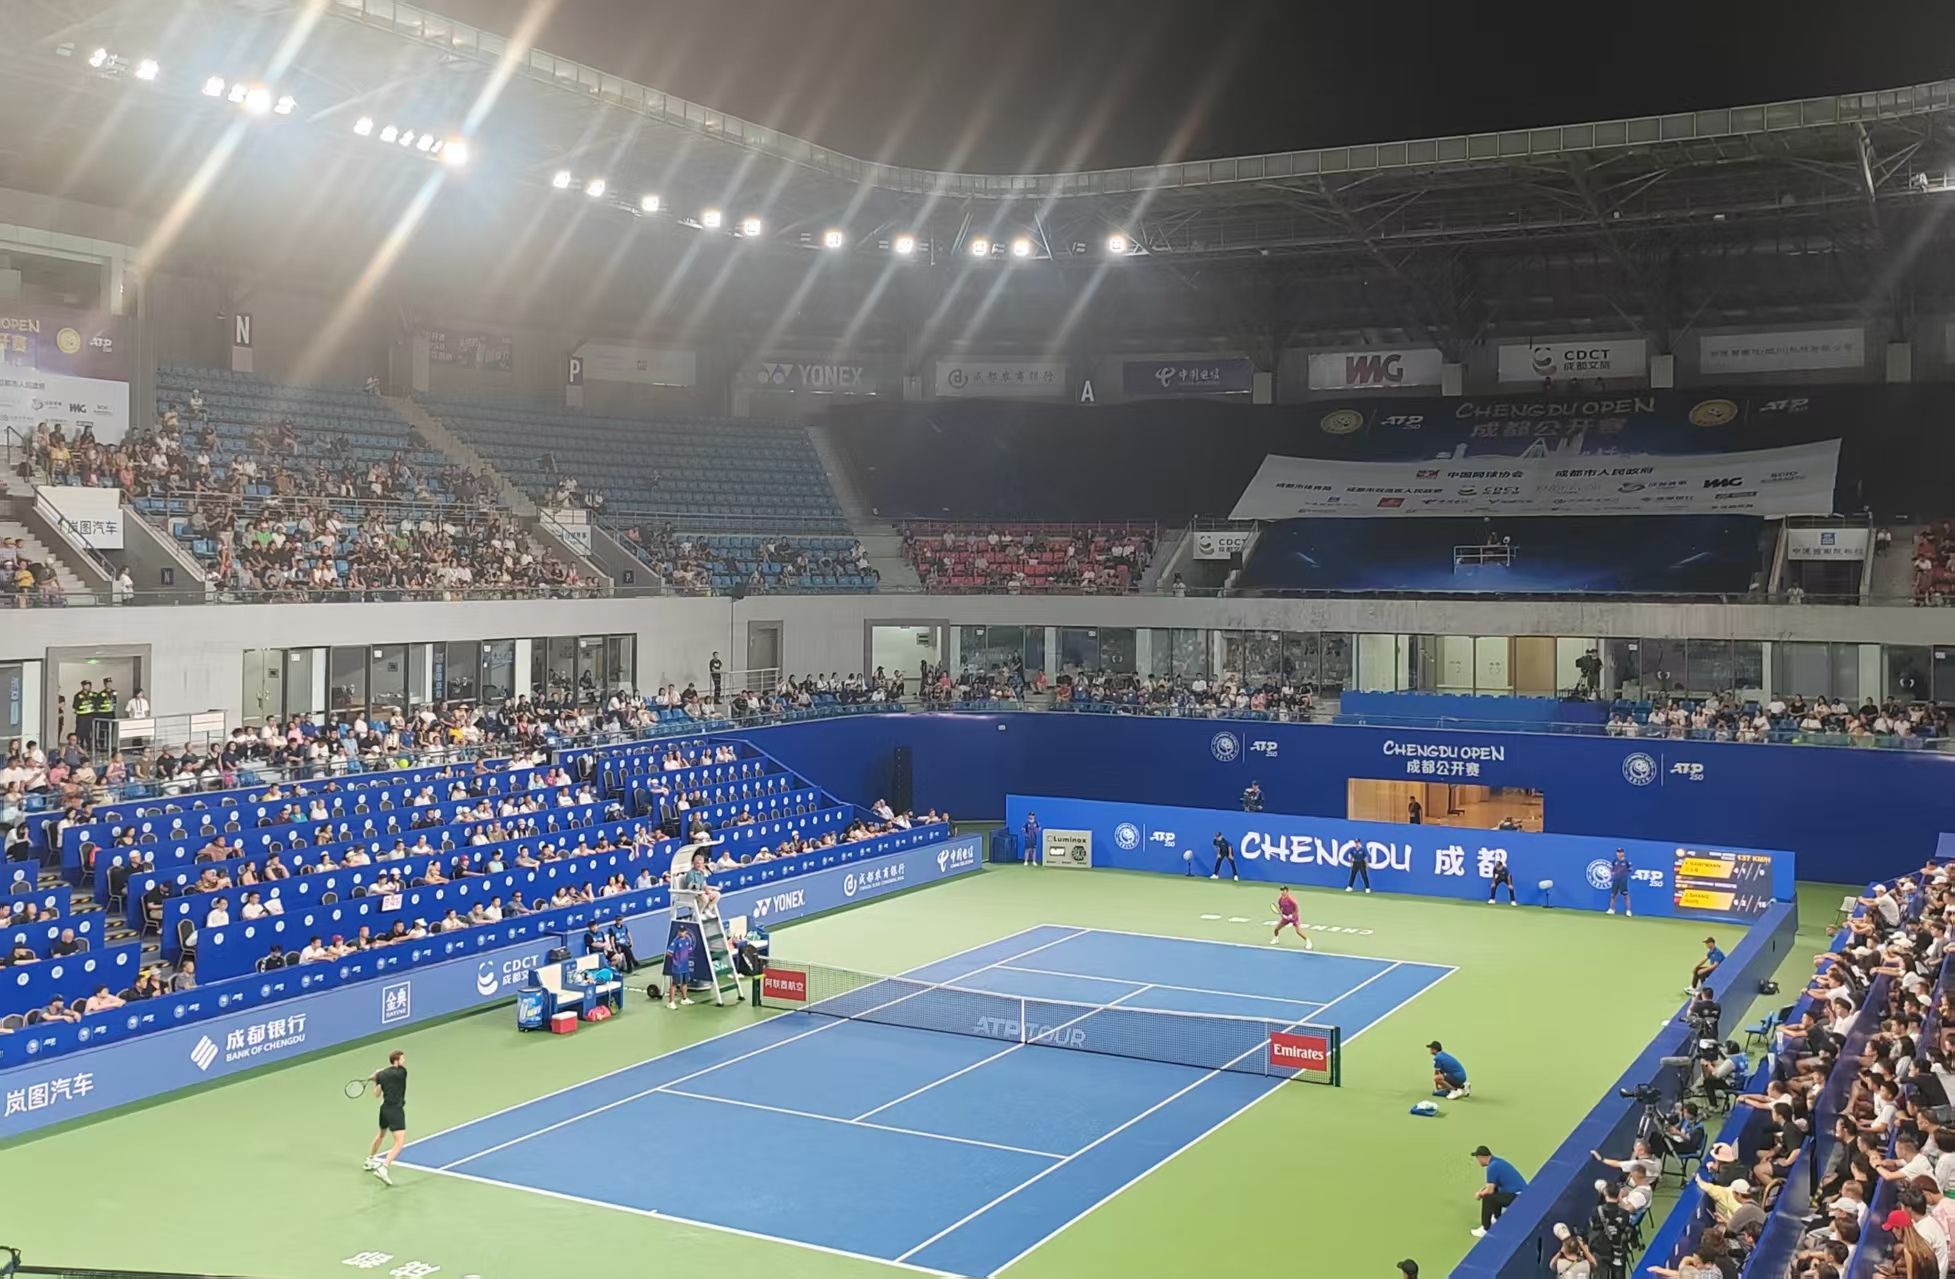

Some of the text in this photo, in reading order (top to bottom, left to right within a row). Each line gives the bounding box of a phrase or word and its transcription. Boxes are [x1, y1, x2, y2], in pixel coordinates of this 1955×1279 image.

[236, 314, 250, 345] N
[1564, 349, 1610, 361] CDCT
[569, 358, 581, 383] P
[798, 364, 864, 386] YONEX
[1080, 380, 1095, 402] A
[1455, 397, 1656, 419] CHENGDU OPEN
[1250, 741, 1278, 751] ATP
[1383, 740, 1505, 761] CHENGDU OPEN
[1406, 759, 1480, 777] 成都公开赛
[1669, 762, 1704, 774] ATP
[1053, 835, 1086, 843] Luminox
[1150, 831, 1176, 841] ATP
[1434, 845, 1508, 878] 成都
[1630, 869, 1664, 881] ATP
[773, 889, 805, 913] YONEX
[502, 954, 539, 973] CDCT
[385, 987, 407, 1012] 金典
[226, 1013, 306, 1051] 成都银行
[973, 1016, 1086, 1048] ATP TOUR
[226, 1033, 306, 1062] BANK OF CHENGDU
[1273, 1043, 1324, 1061] Emirates
[4, 1072, 94, 1117] 岚图汽车
